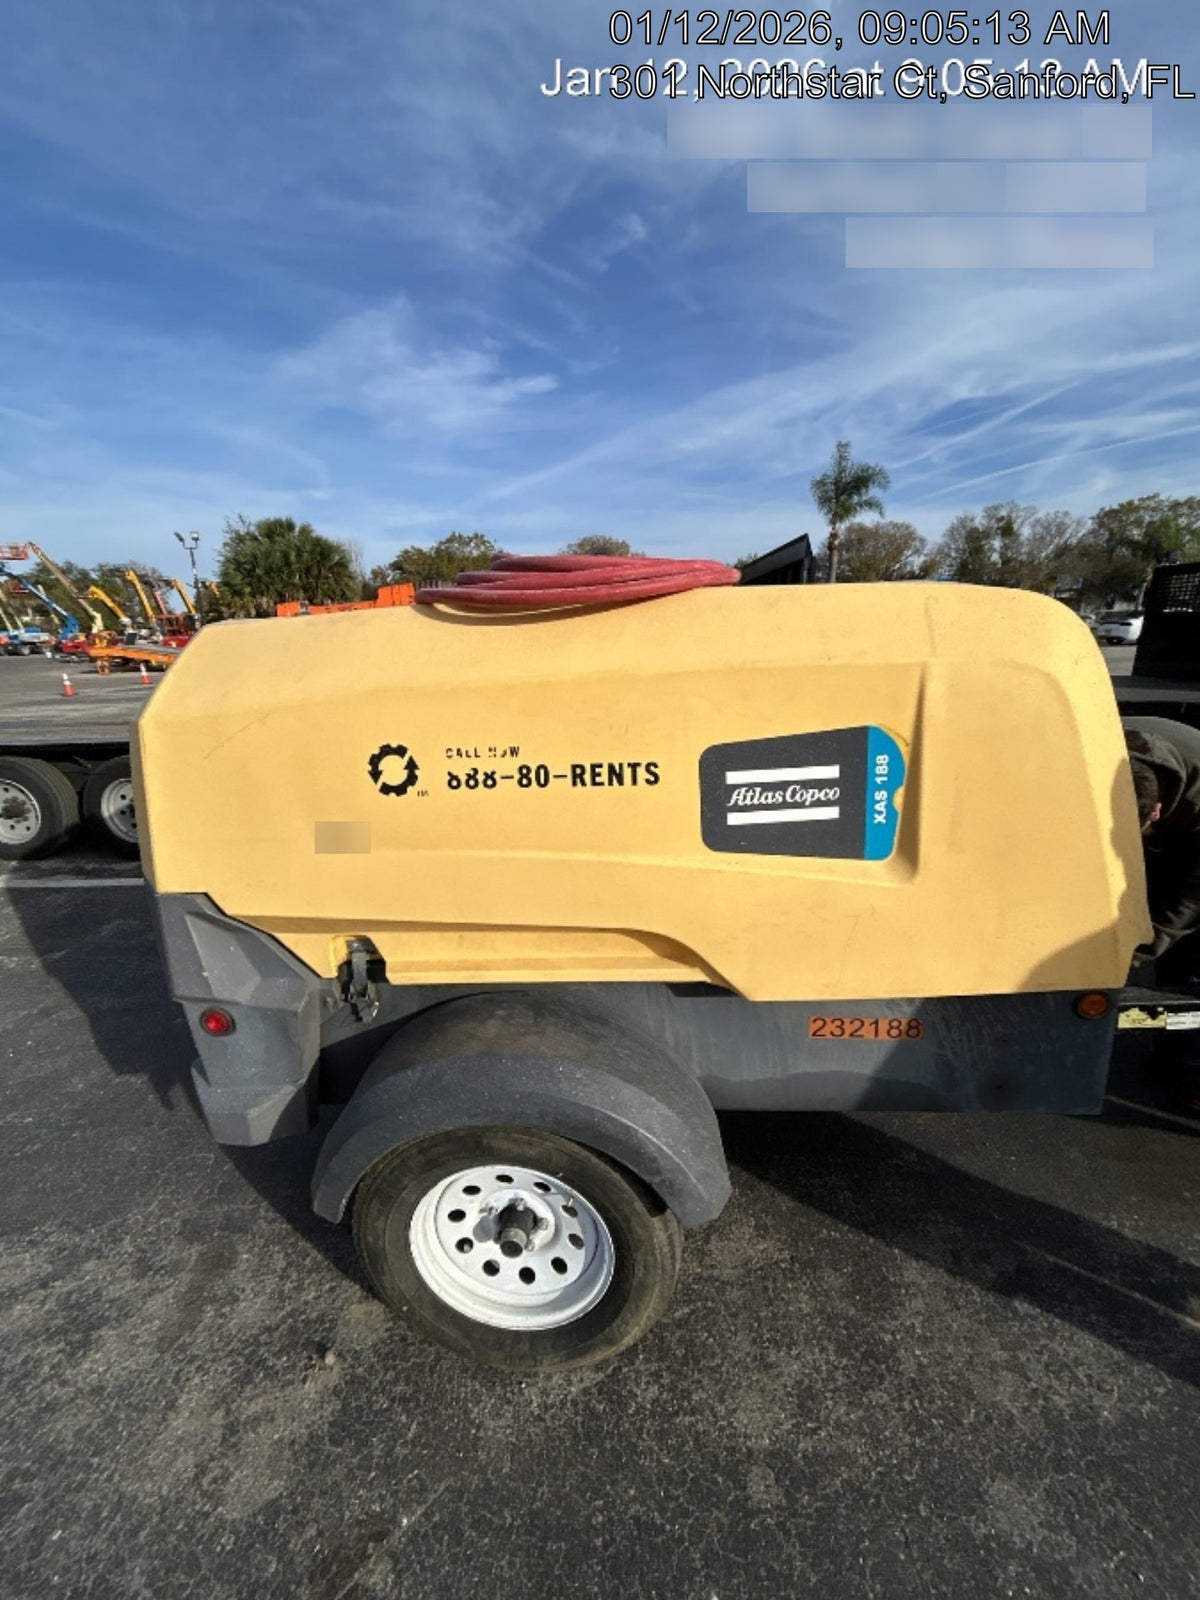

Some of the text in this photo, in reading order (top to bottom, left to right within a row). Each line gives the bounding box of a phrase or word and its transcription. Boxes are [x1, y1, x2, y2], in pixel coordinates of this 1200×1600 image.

[727, 784, 840, 807] Atlas Copco
[873, 754, 890, 824] XAS 188
[811, 1017, 921, 1039] 232188
